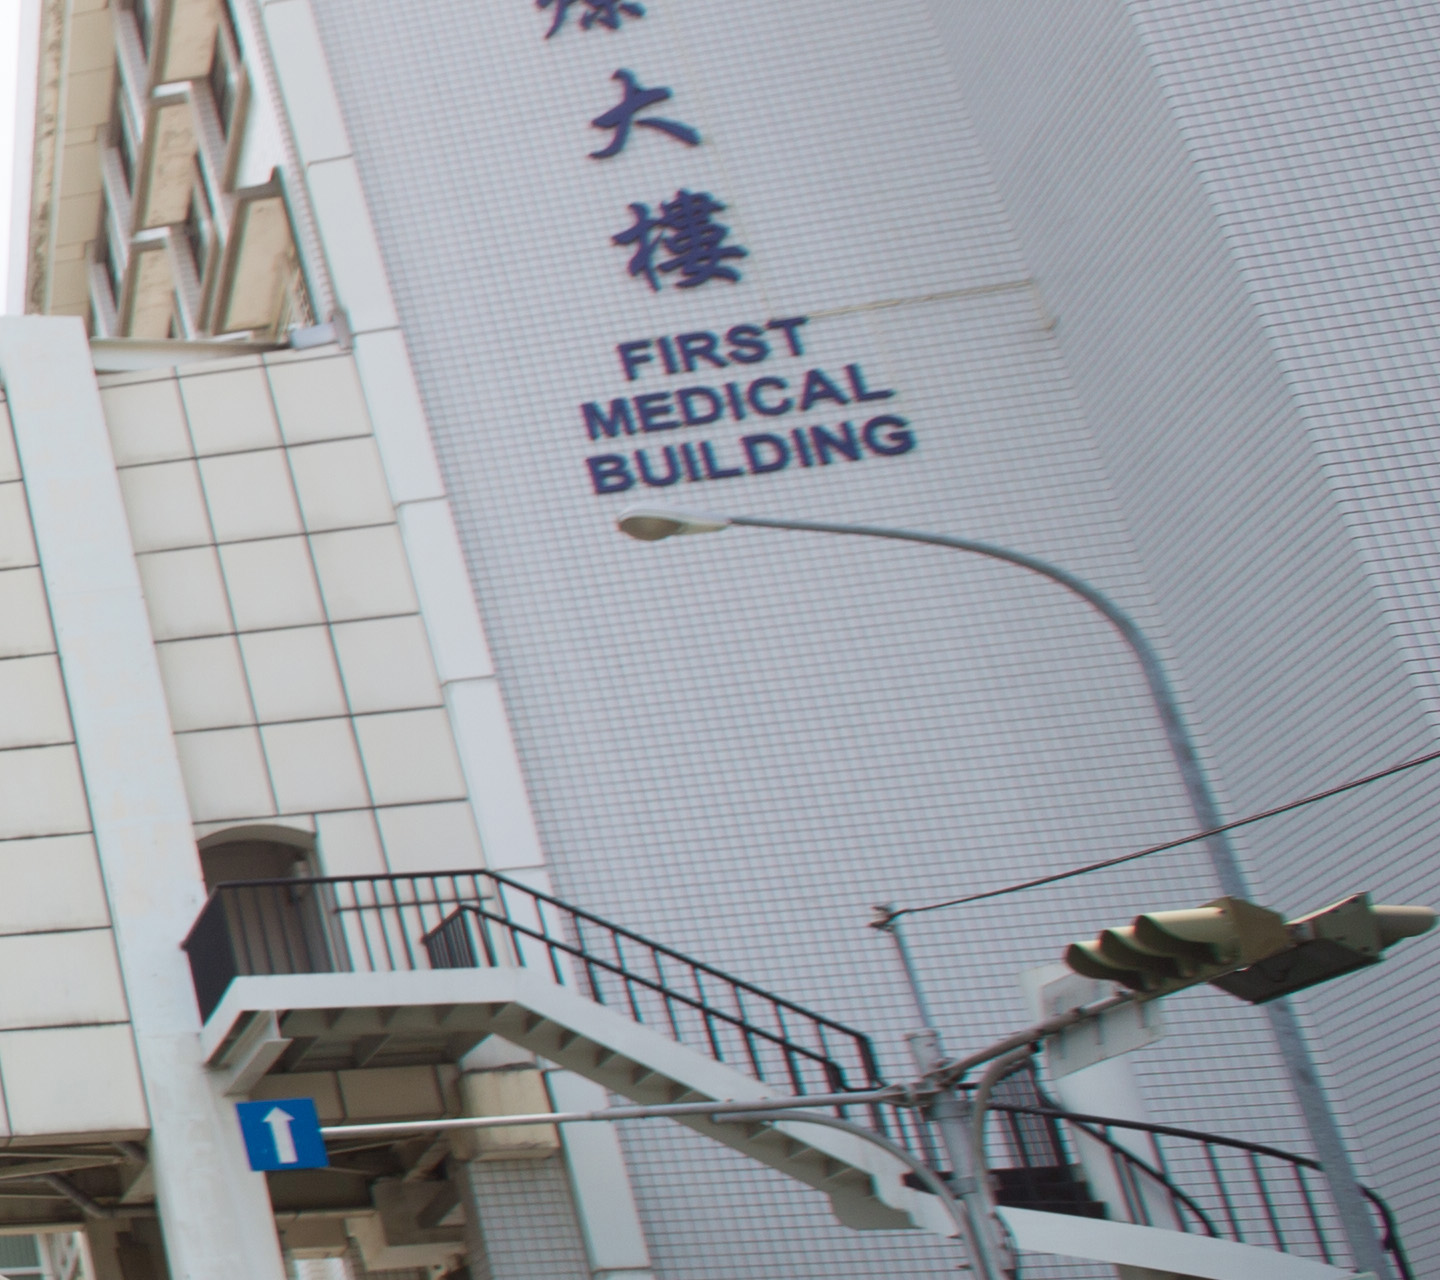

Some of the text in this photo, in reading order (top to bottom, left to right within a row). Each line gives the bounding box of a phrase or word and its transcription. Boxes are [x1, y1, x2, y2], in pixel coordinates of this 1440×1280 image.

[616, 316, 810, 381] FIRST
[581, 363, 896, 441] MEDICAL
[585, 413, 917, 496] BUILDING
